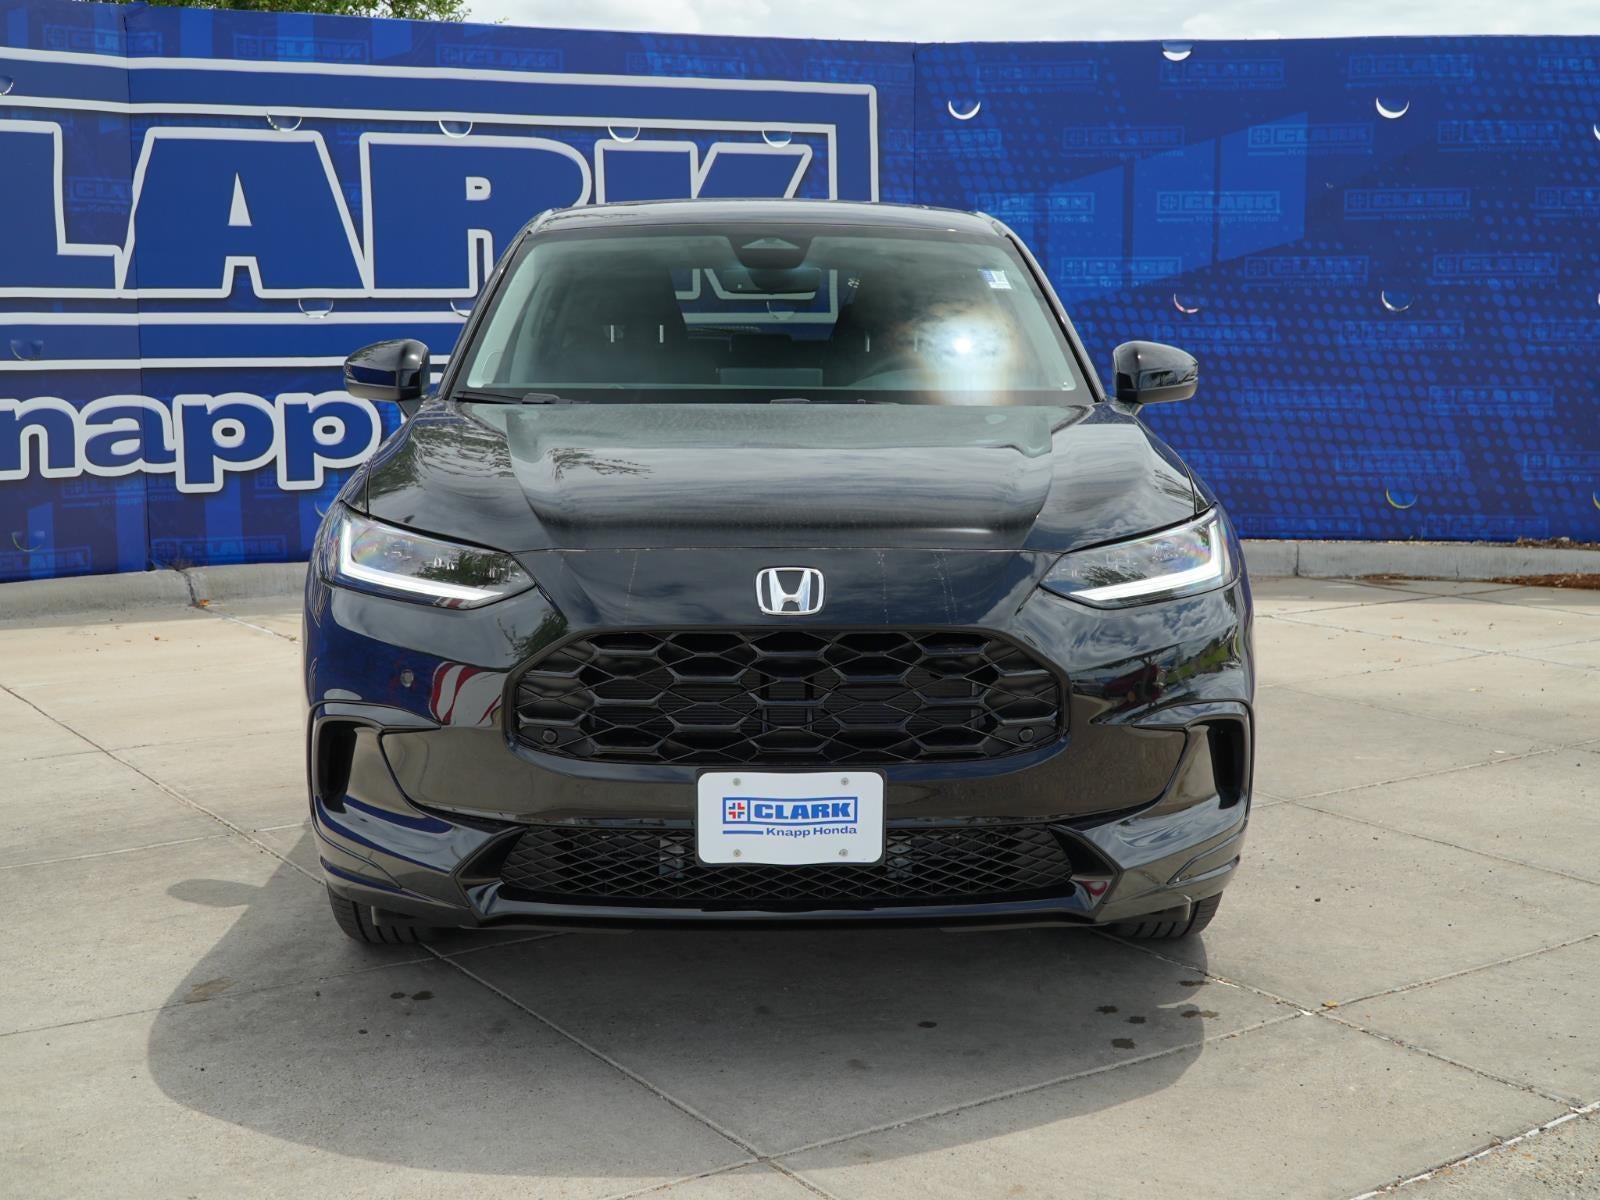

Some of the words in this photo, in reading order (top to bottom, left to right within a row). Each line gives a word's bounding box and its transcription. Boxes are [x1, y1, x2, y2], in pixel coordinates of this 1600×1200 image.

[1184, 195, 1273, 209] CLARK
[754, 802, 850, 819] CLARK
[766, 827, 810, 838] Knapp
[813, 826, 857, 836] Honda
